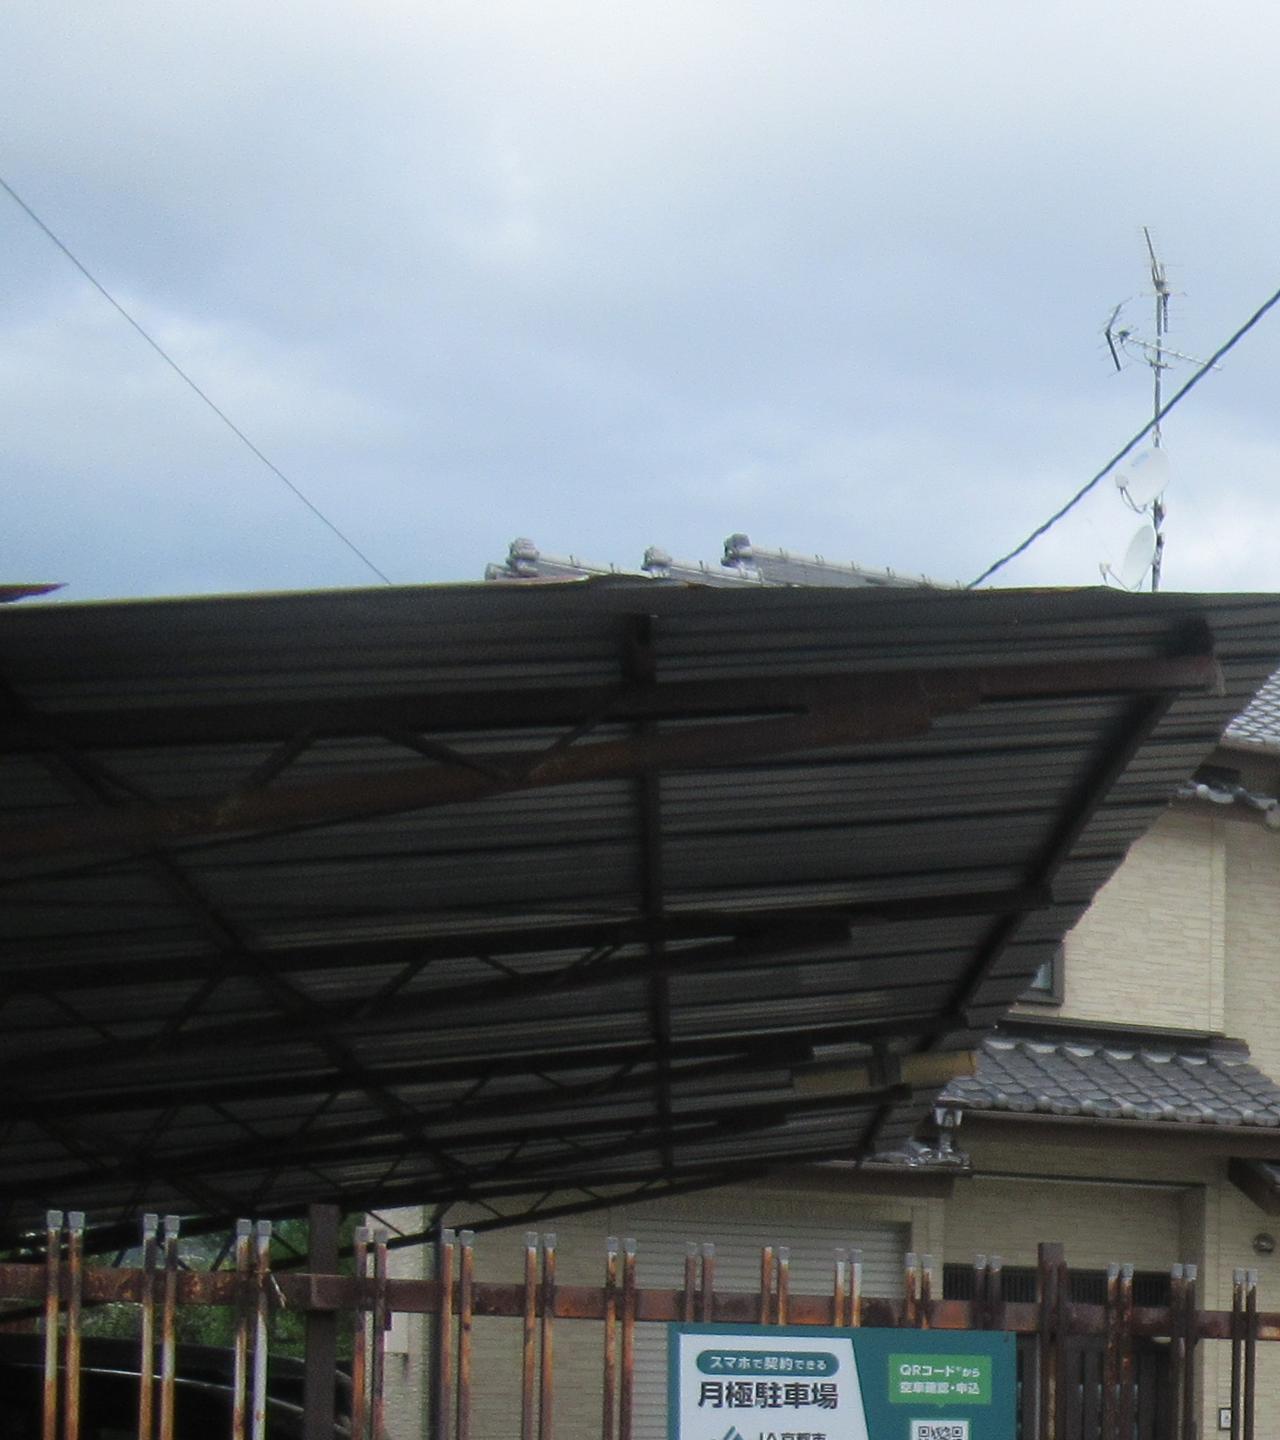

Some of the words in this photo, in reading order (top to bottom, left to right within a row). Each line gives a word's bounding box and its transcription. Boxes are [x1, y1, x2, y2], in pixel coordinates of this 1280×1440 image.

[710, 1356, 827, 1371] スマホで契約できる
[698, 1381, 839, 1409] 月極駐車場
